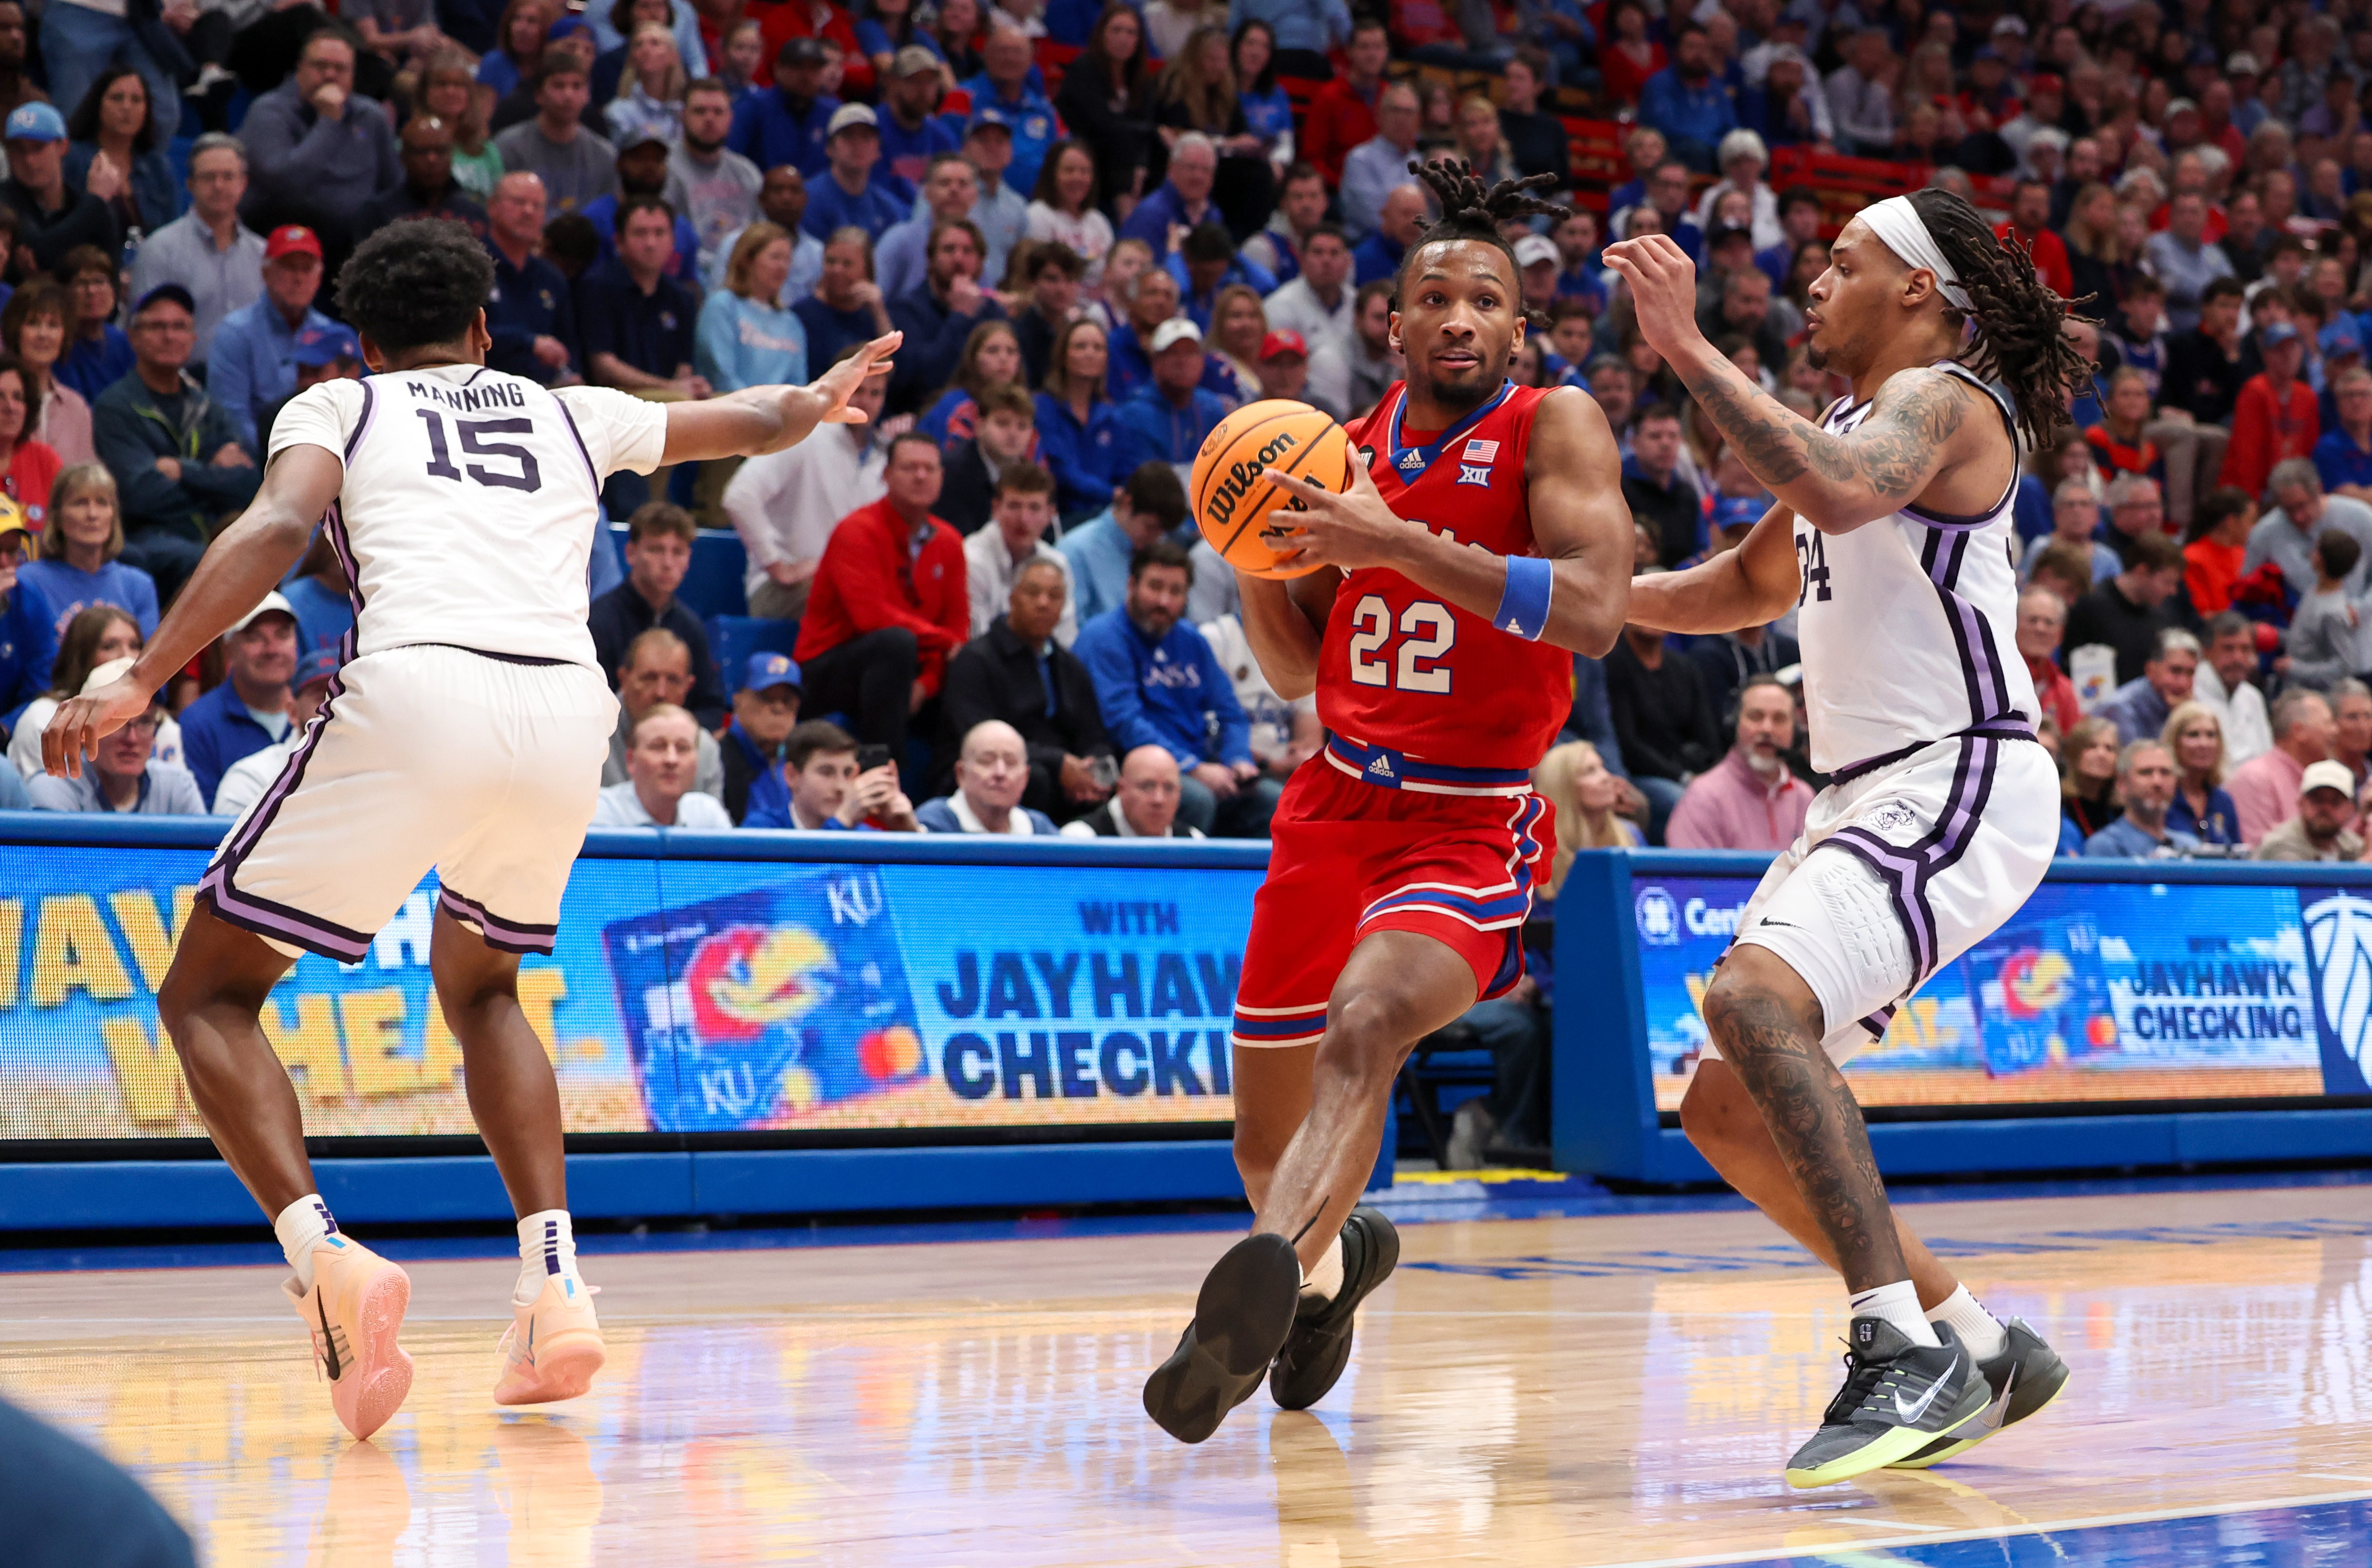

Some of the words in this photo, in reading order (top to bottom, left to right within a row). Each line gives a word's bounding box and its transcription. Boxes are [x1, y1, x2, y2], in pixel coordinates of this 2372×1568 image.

[406, 382, 526, 412] MANNING
[415, 408, 542, 493] 15
[1399, 460, 1426, 470] adidas
[1207, 431, 1298, 525] Wilson
[1457, 464, 1492, 488] XII
[1795, 527, 1832, 608] 34
[1349, 594, 1457, 695] 22
[1368, 765, 1394, 778] adidas
[827, 871, 882, 927] KU
[1077, 901, 1179, 935] WITH
[2133, 962, 2297, 996] JAYHAWK
[1721, 1015, 1808, 1062] RANGERS
[2135, 1005, 2303, 1039] CHECKING
[700, 1062, 757, 1115] KU
[943, 1031, 1231, 1099] CHECKI
